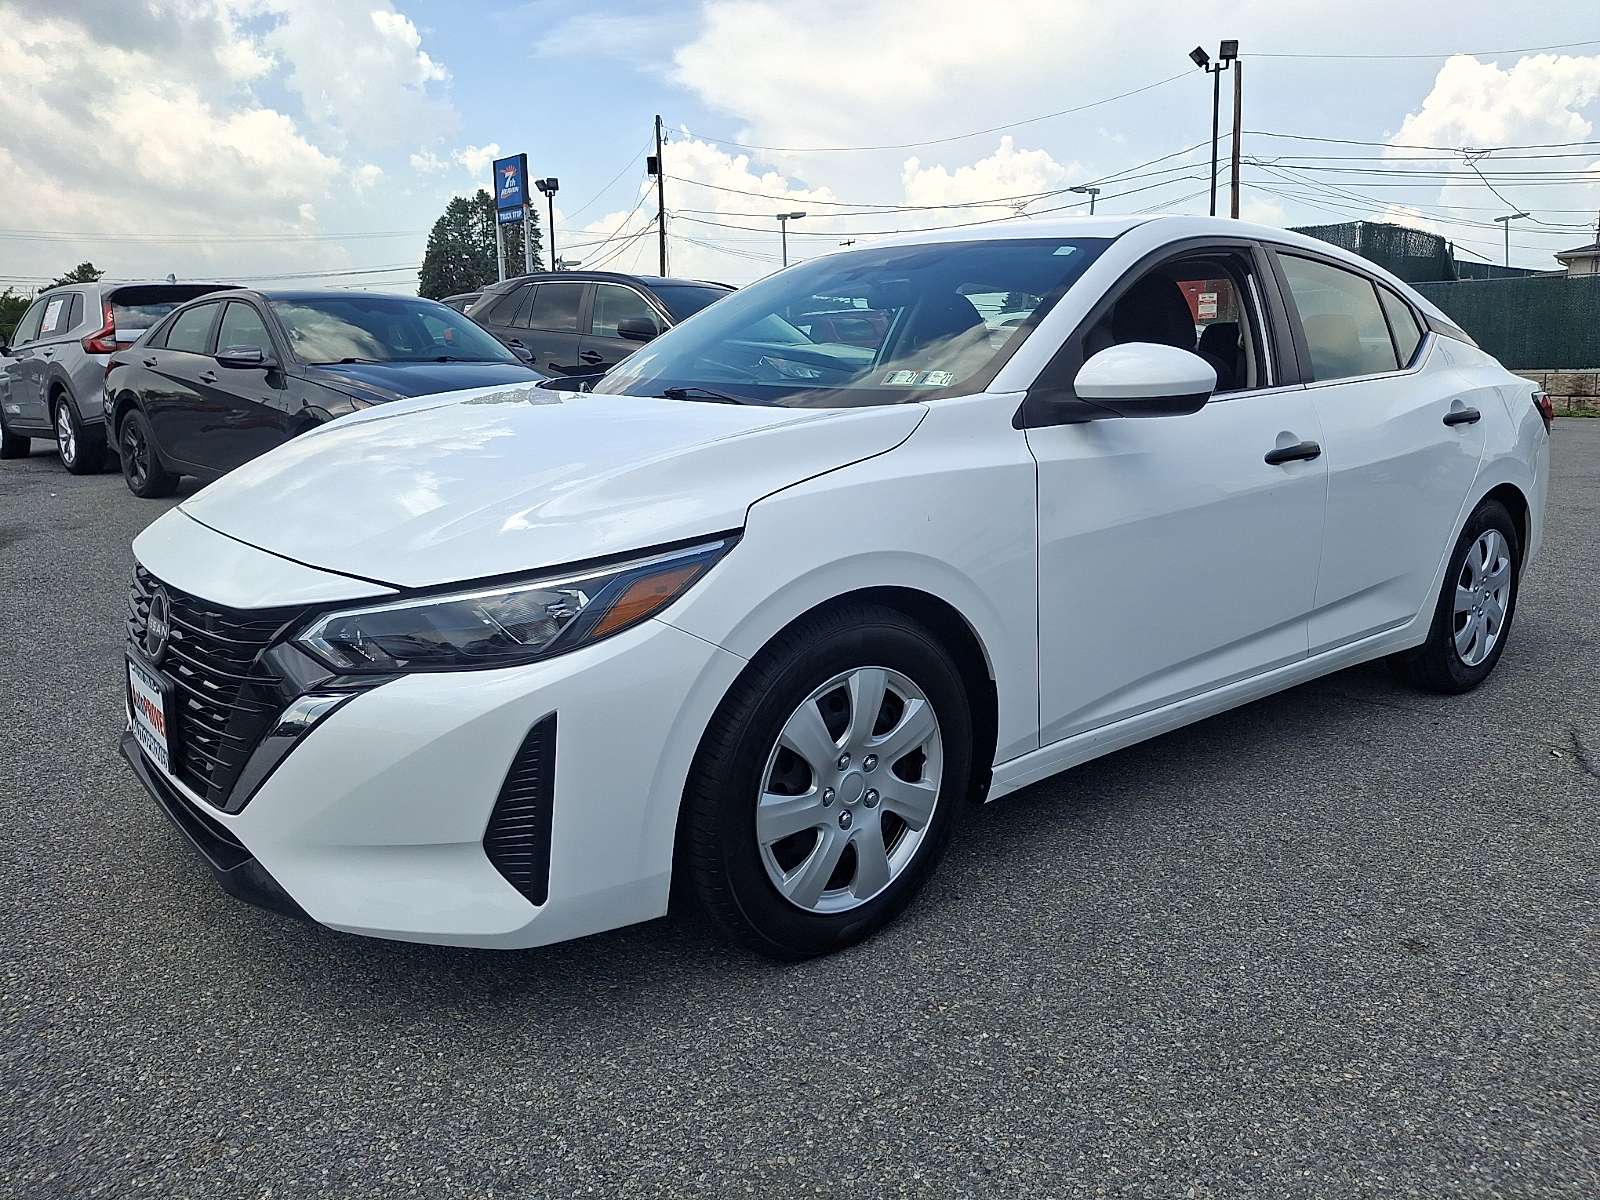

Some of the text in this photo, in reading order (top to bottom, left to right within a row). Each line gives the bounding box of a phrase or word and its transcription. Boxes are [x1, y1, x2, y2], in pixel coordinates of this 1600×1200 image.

[501, 186, 519, 196] HEAVEN
[500, 210, 522, 221] TRUCK STOP
